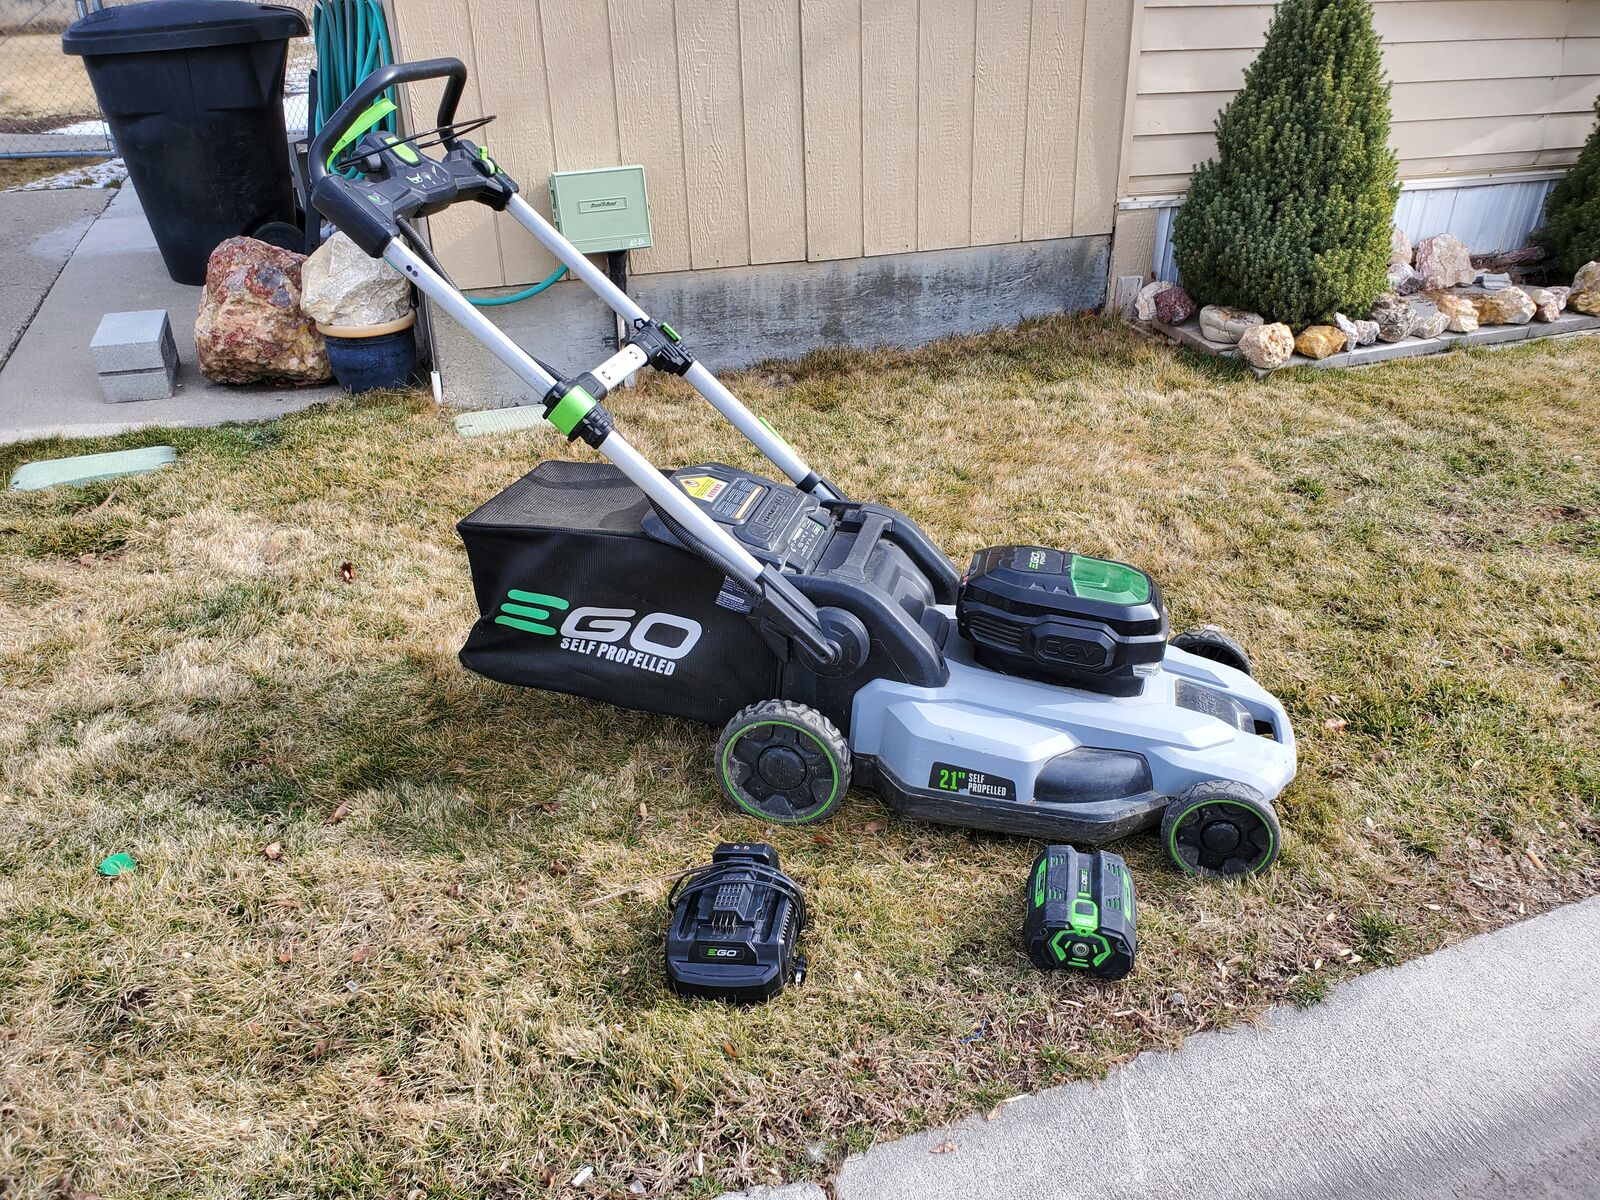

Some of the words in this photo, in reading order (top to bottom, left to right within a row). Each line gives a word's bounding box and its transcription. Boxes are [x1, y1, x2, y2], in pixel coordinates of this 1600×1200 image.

[1028, 551, 1040, 570] EGO
[494, 589, 703, 660] EGO
[560, 636, 597, 656] SELF
[596, 642, 676, 676] PROPELLED
[939, 769, 965, 790] 21"
[968, 773, 985, 784] SELF
[968, 783, 1007, 796] PROPELLED
[707, 948, 737, 957] EGO
